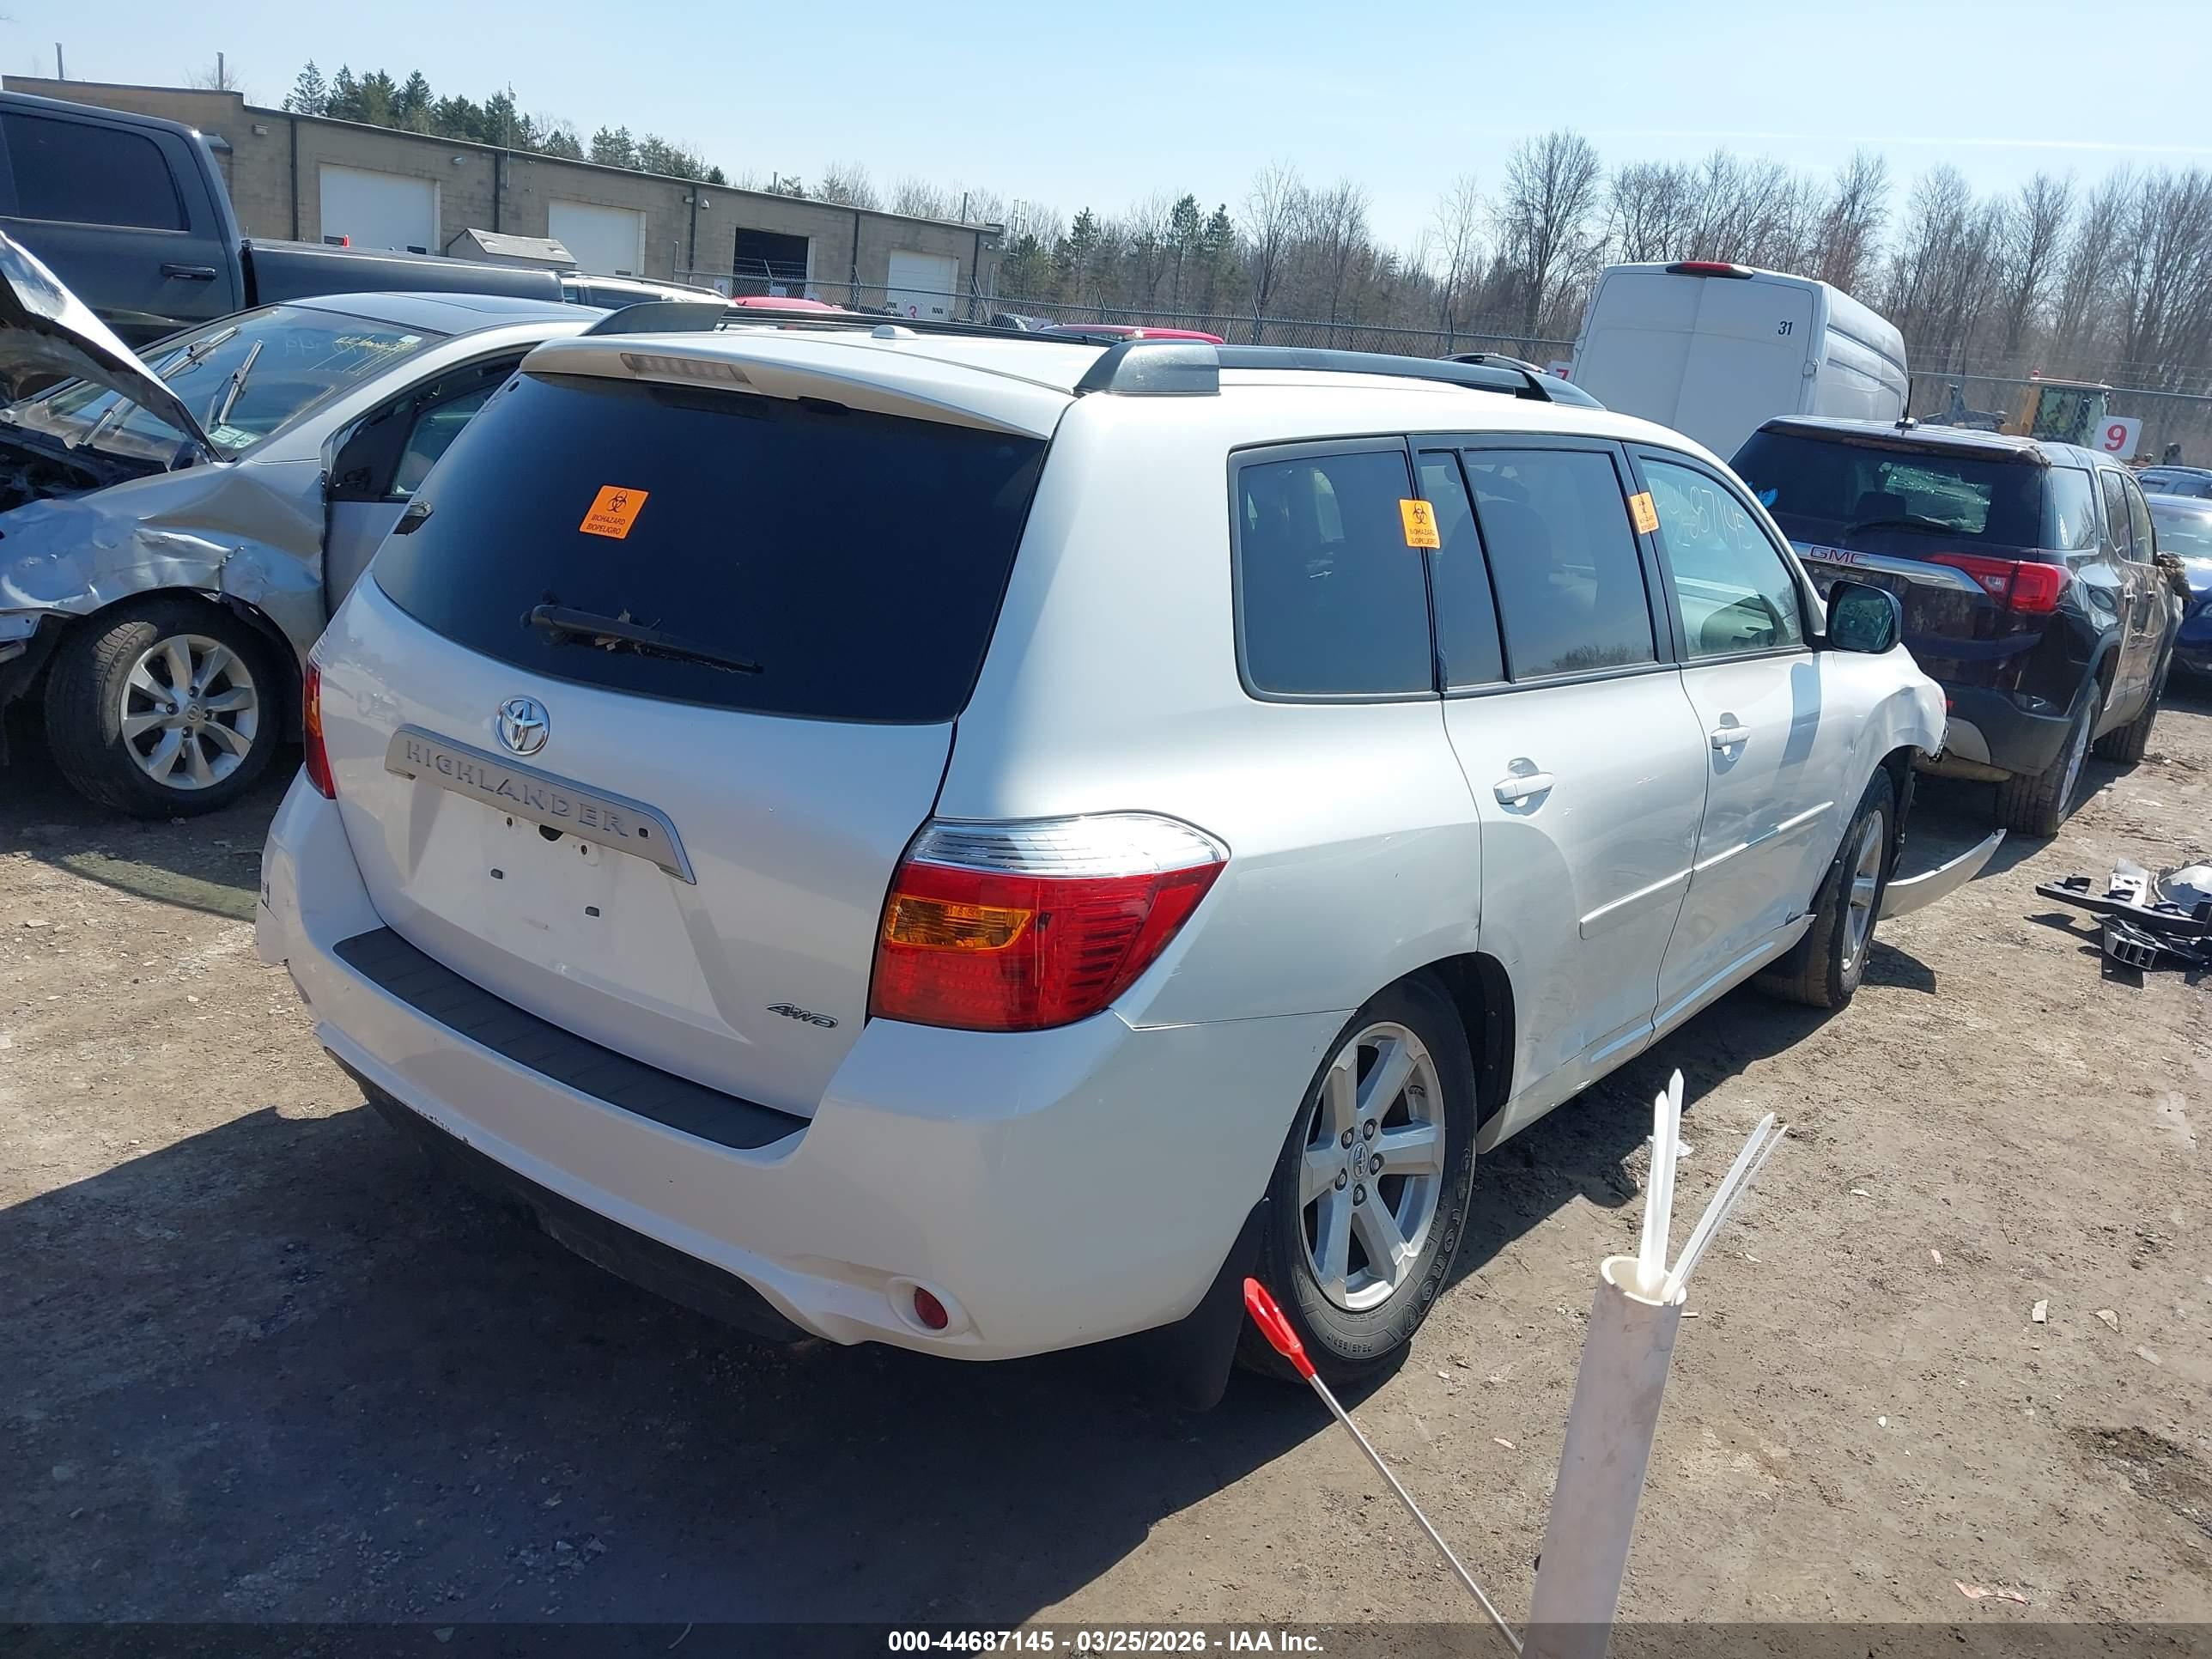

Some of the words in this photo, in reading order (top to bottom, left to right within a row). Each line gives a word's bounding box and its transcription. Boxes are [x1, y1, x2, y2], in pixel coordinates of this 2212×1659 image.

[1778, 320, 1793, 336] 31
[1555, 368, 1570, 381] 7
[2104, 424, 2128, 452] 9
[586, 522, 622, 535] BIOPELIGRO
[591, 514, 626, 526] BIOHAZARD
[1809, 545, 1870, 568] GMC
[405, 740, 629, 838] HIGHLANDER
[766, 1001, 839, 1029] 4WD
